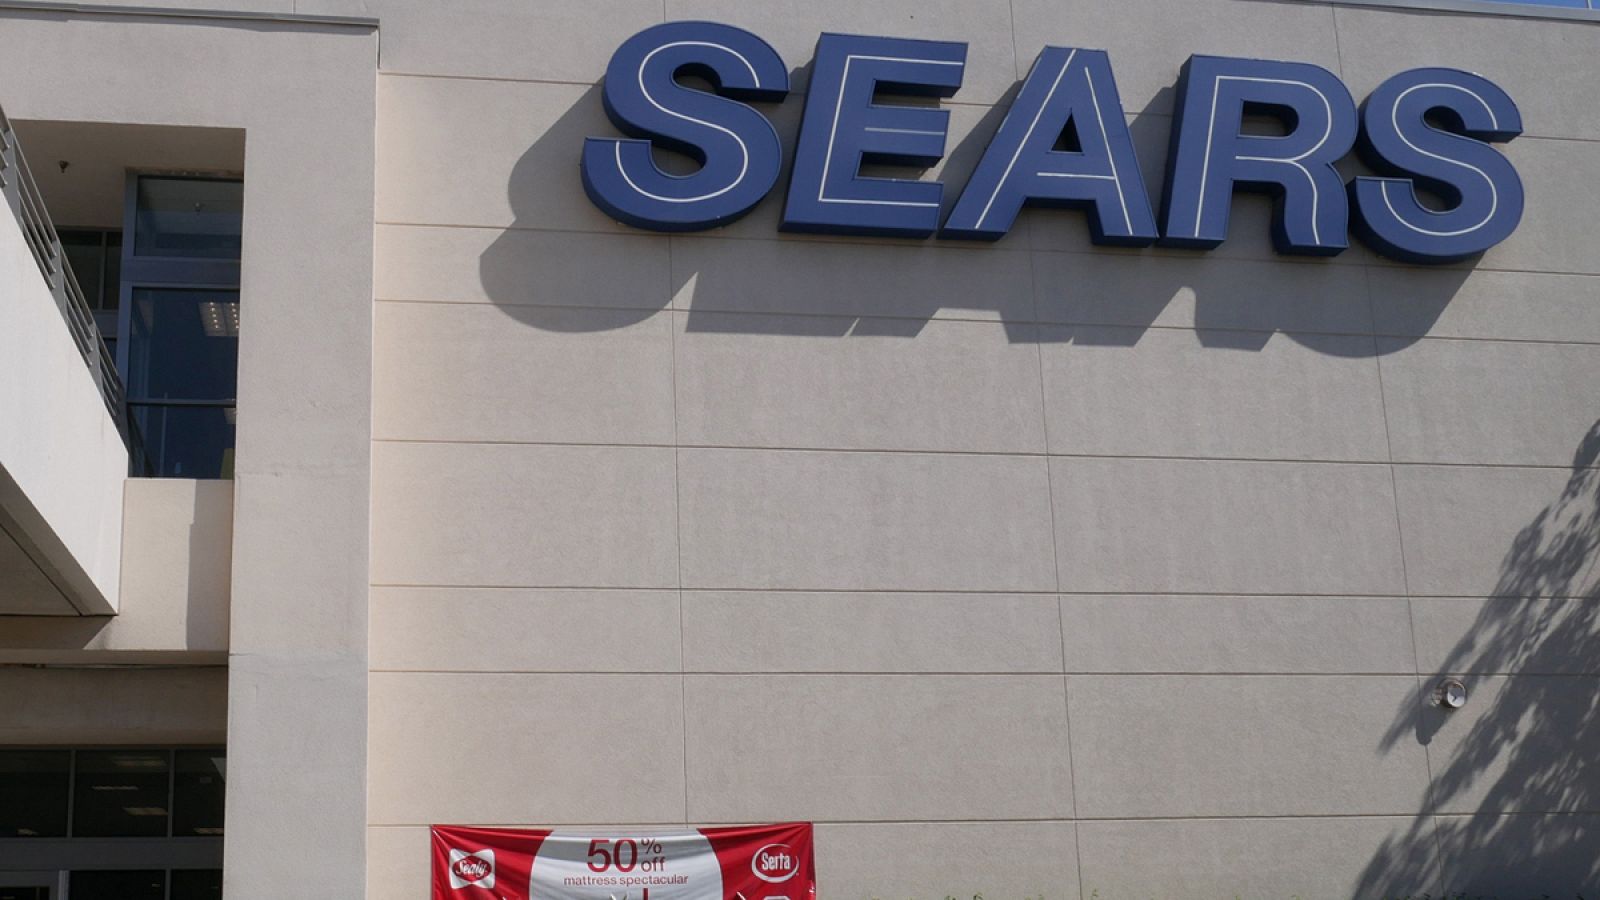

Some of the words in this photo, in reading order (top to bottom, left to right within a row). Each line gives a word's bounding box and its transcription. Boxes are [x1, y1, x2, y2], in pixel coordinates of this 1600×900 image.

[582, 21, 1526, 264] SEARS
[587, 838, 663, 873] 50%
[641, 856, 666, 873] off
[761, 852, 791, 871] Serta
[455, 858, 487, 877] Sealy
[563, 875, 617, 886] mattress
[618, 874, 689, 887] spectacular
